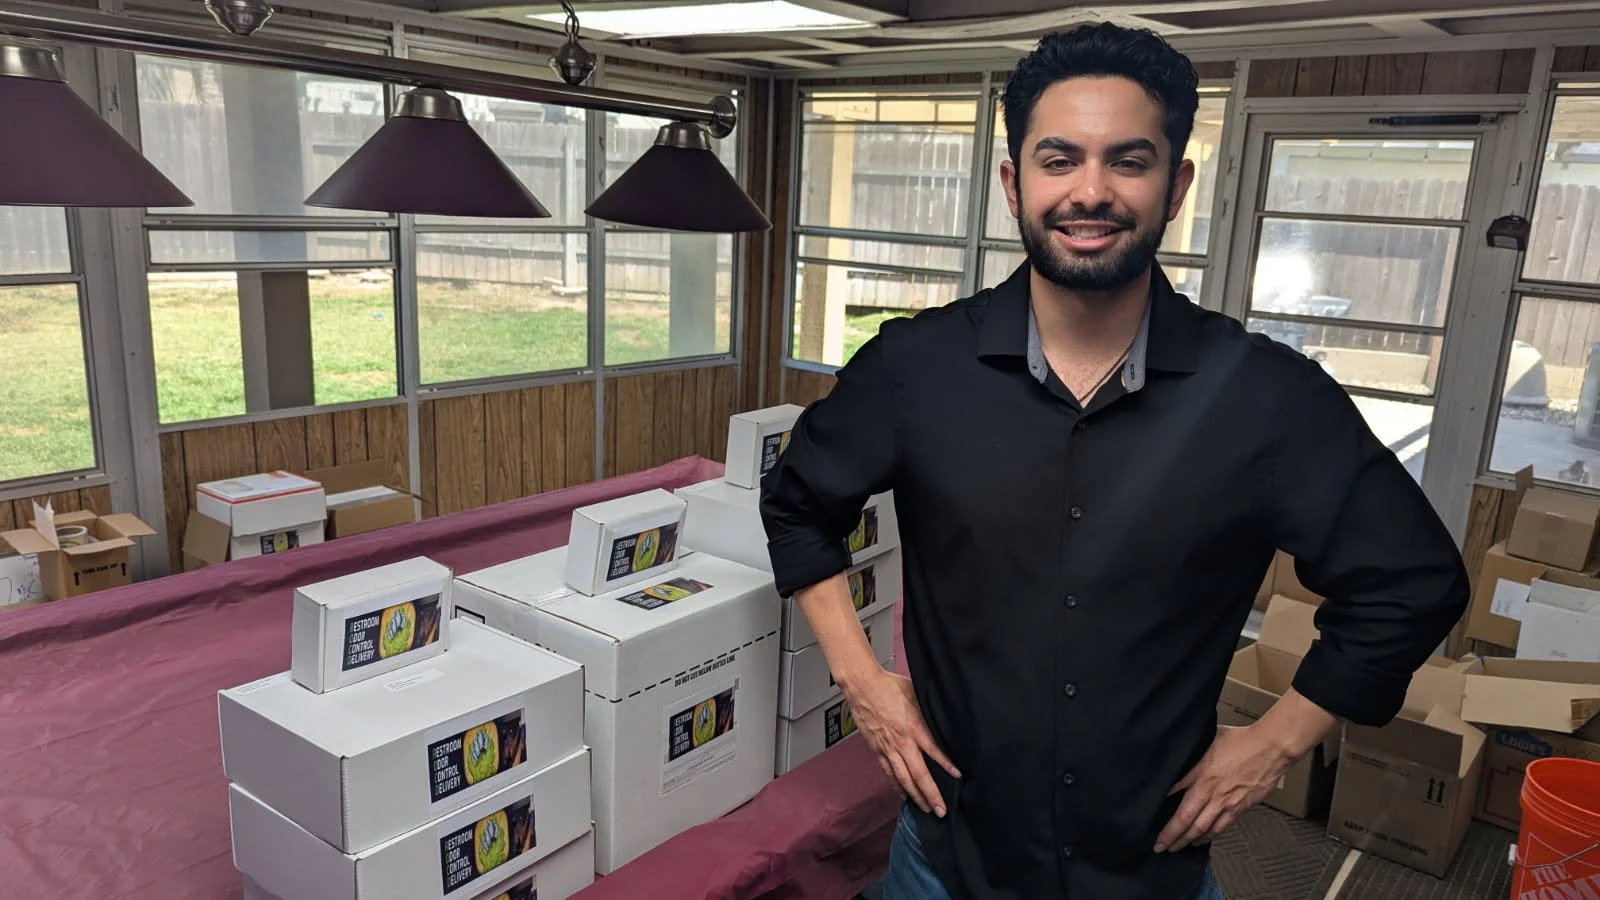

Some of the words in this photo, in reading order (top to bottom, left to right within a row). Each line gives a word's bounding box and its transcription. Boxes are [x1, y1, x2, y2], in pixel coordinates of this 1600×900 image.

[349, 615, 380, 633] RESTROOM
[348, 640, 374, 655] CONTROL
[349, 631, 366, 643] ODOR
[347, 649, 375, 666] DELIVERY
[432, 738, 462, 759] RESTROOM
[433, 756, 449, 771] ODOR
[434, 764, 459, 783] CONTROL
[435, 775, 461, 796] DELIVERY
[444, 828, 473, 851] RESTROOM
[446, 855, 471, 876] CONTROL
[1530, 864, 1573, 885] THE
[447, 865, 472, 888] DELIVERY
[1518, 874, 1600, 900] OM
